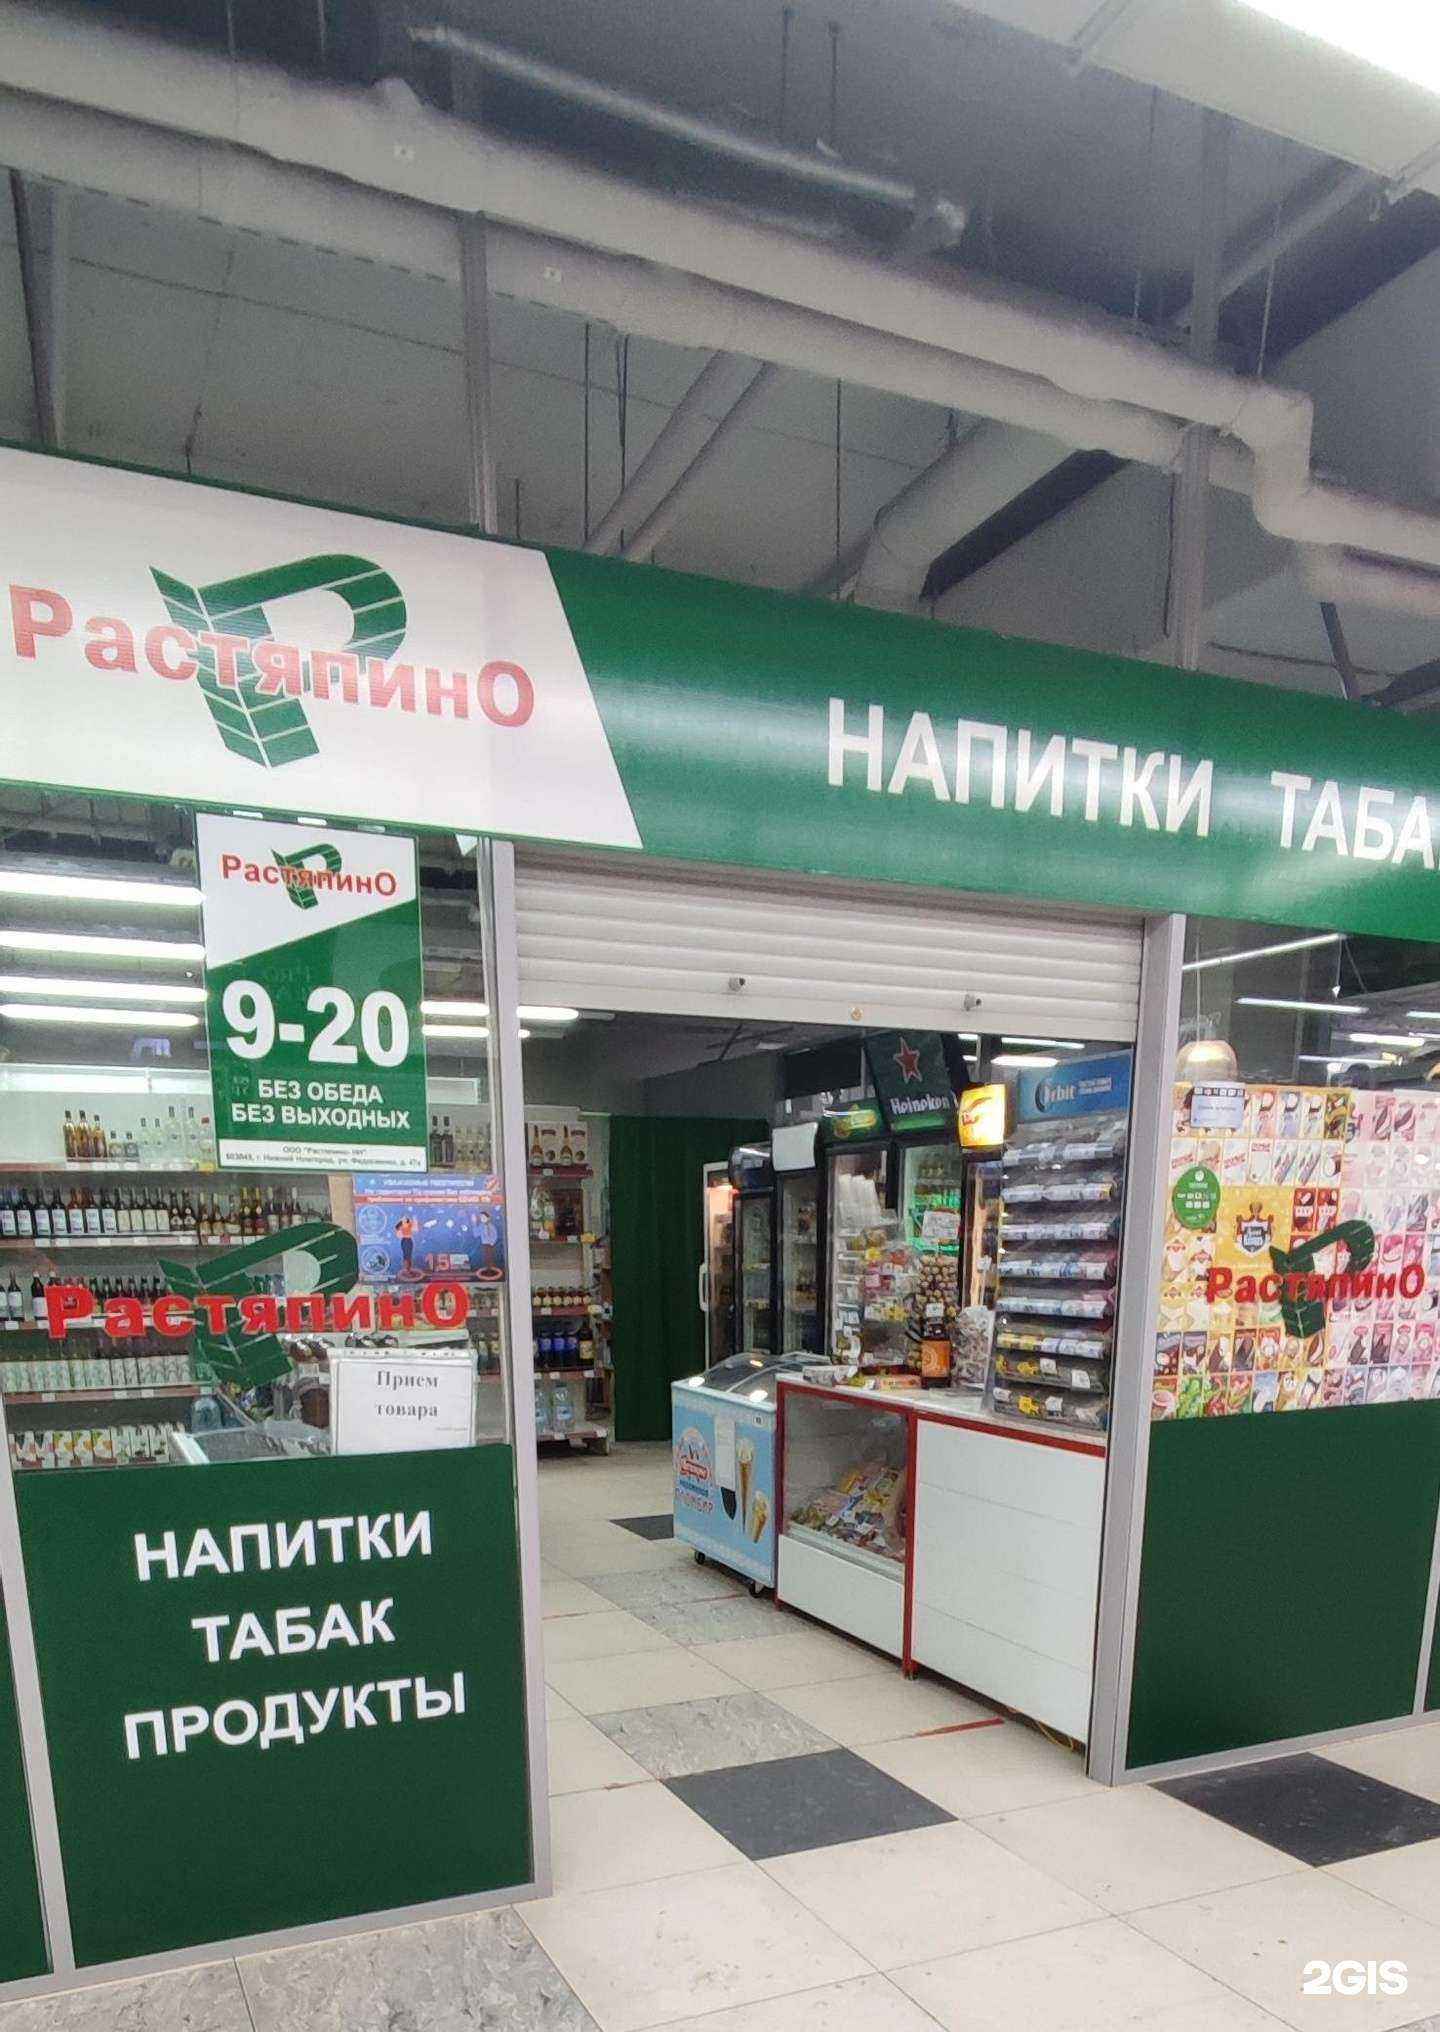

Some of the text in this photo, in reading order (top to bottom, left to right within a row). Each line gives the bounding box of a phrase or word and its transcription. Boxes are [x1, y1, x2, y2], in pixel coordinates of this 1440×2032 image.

[827, 697, 1440, 870] НАПИТКИ ТАБА
[221, 979, 410, 1068] 9-20
[258, 1079, 384, 1106] БЕЗ ОБЕДА
[890, 1093, 950, 1115] Heineken
[231, 1103, 412, 1130] БЕЗ ВЫХОДНЫХ
[376, 1370, 439, 1391] Прием
[376, 1403, 438, 1421] товара
[134, 1510, 432, 1581] НАПИТКИ
[191, 1597, 396, 1663] ТАБАК
[124, 1671, 466, 1760] ПРОДУКТЫ
